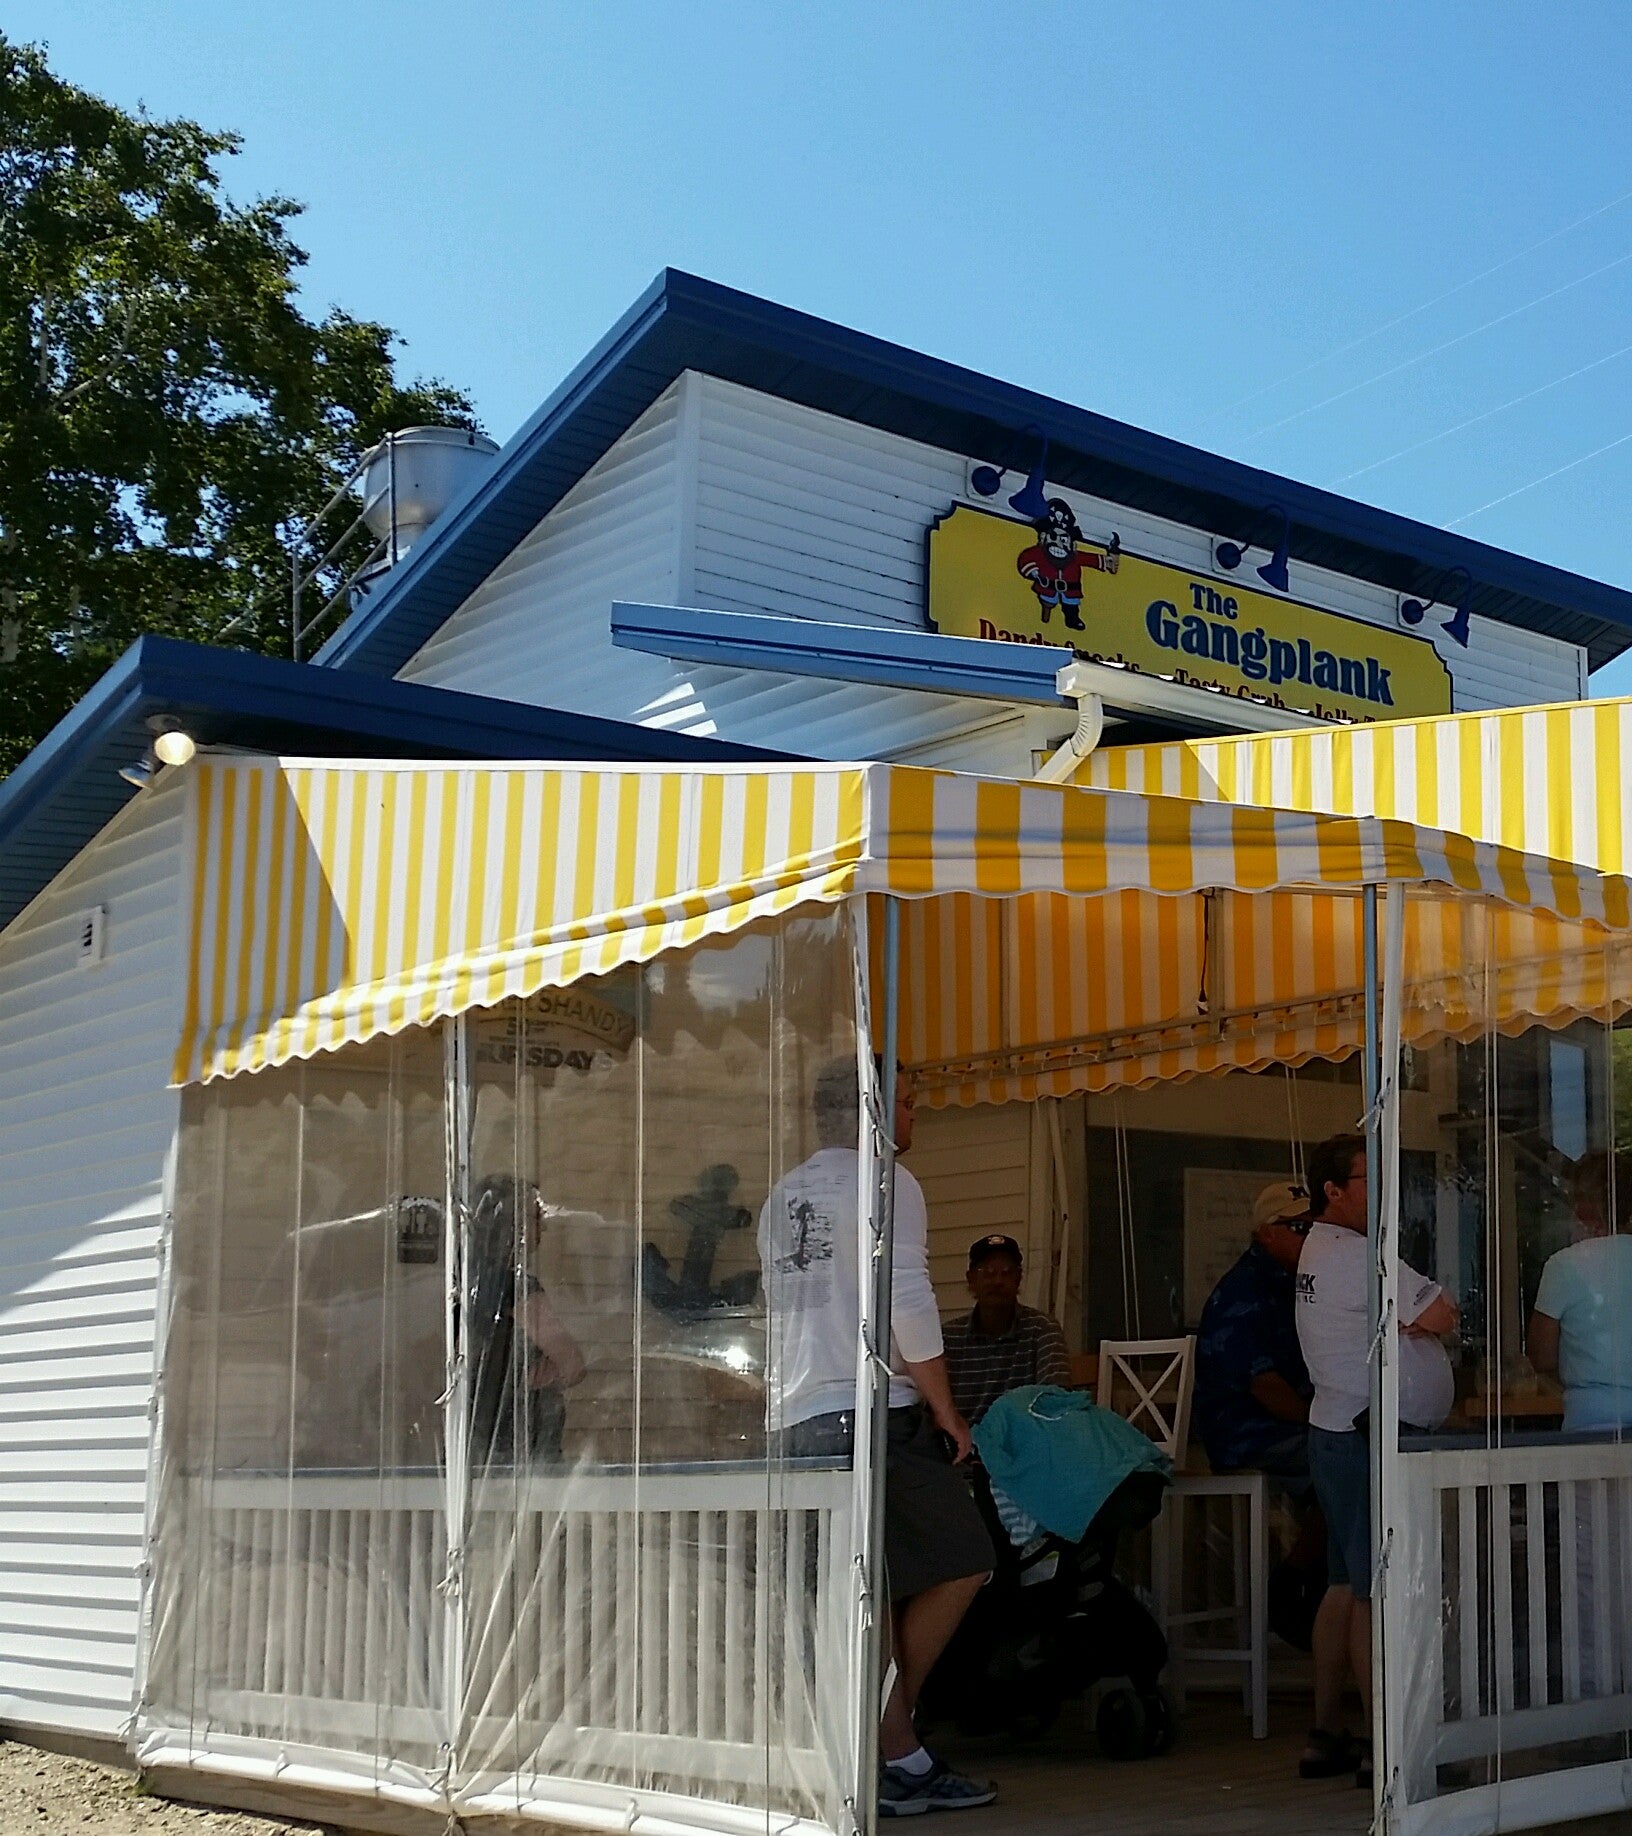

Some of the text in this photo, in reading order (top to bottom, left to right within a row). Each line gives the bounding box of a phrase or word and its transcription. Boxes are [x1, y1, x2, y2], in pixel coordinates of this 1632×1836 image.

[1189, 582, 1239, 621] The
[1145, 600, 1395, 707] Gangplank
[1238, 685, 1285, 709] Gb
[1316, 703, 1359, 724] Joll
[538, 994, 631, 1036] SHANDY
